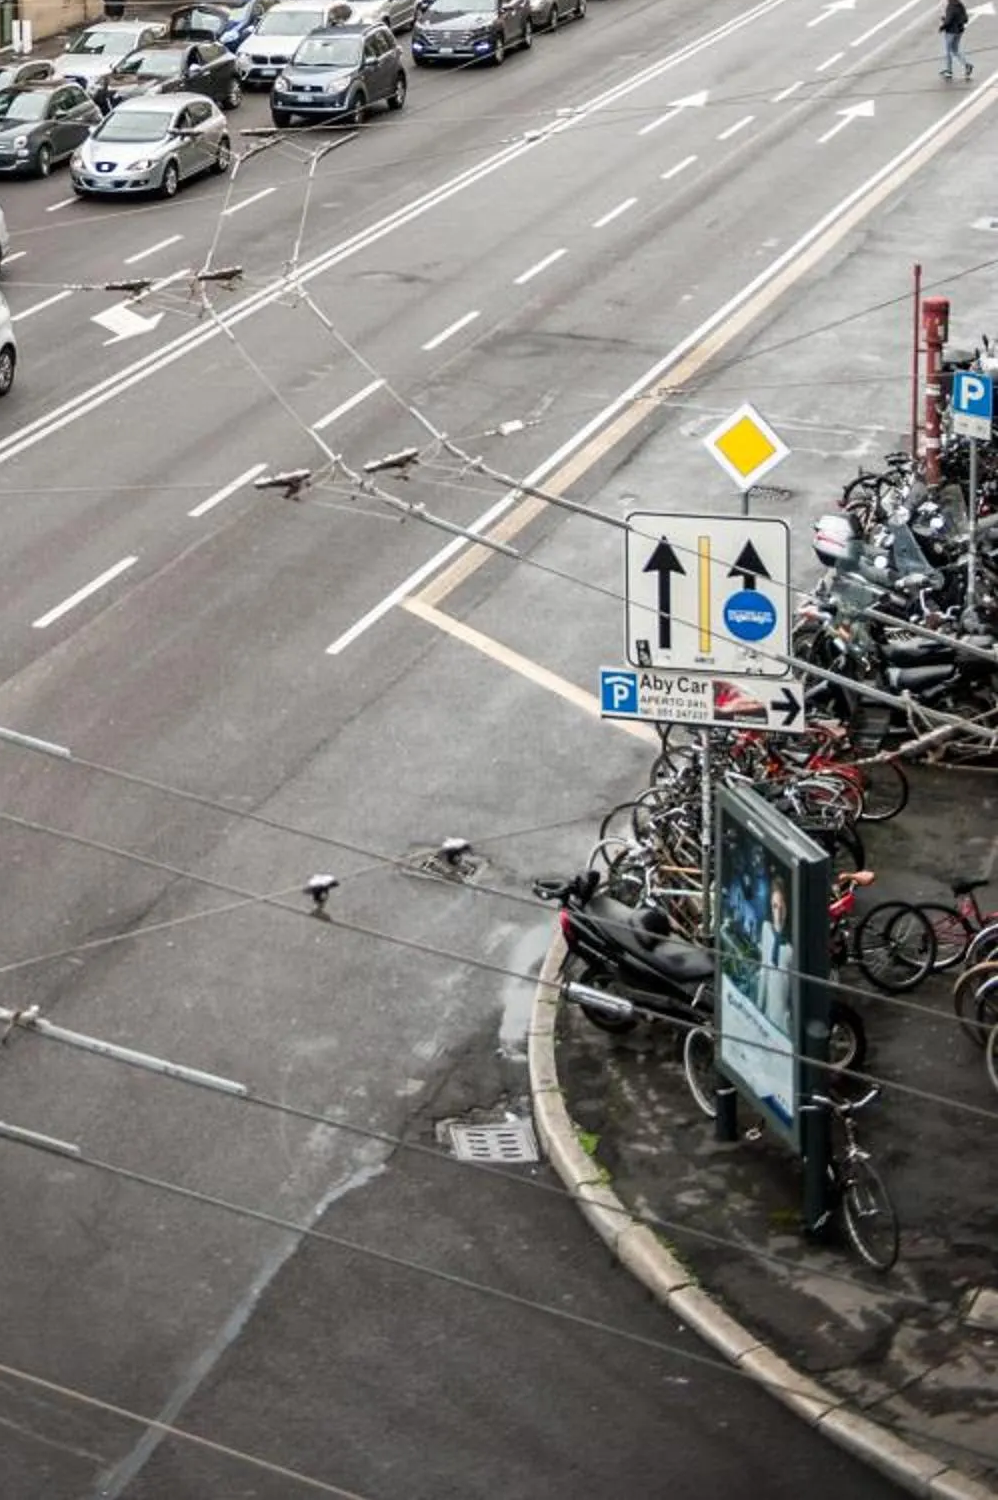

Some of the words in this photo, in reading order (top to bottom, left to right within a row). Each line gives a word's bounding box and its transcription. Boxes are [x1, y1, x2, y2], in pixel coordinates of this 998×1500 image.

[960, 375, 985, 410] P
[613, 684, 630, 709] P
[640, 673, 673, 695] Aby
[677, 677, 708, 694] Car
